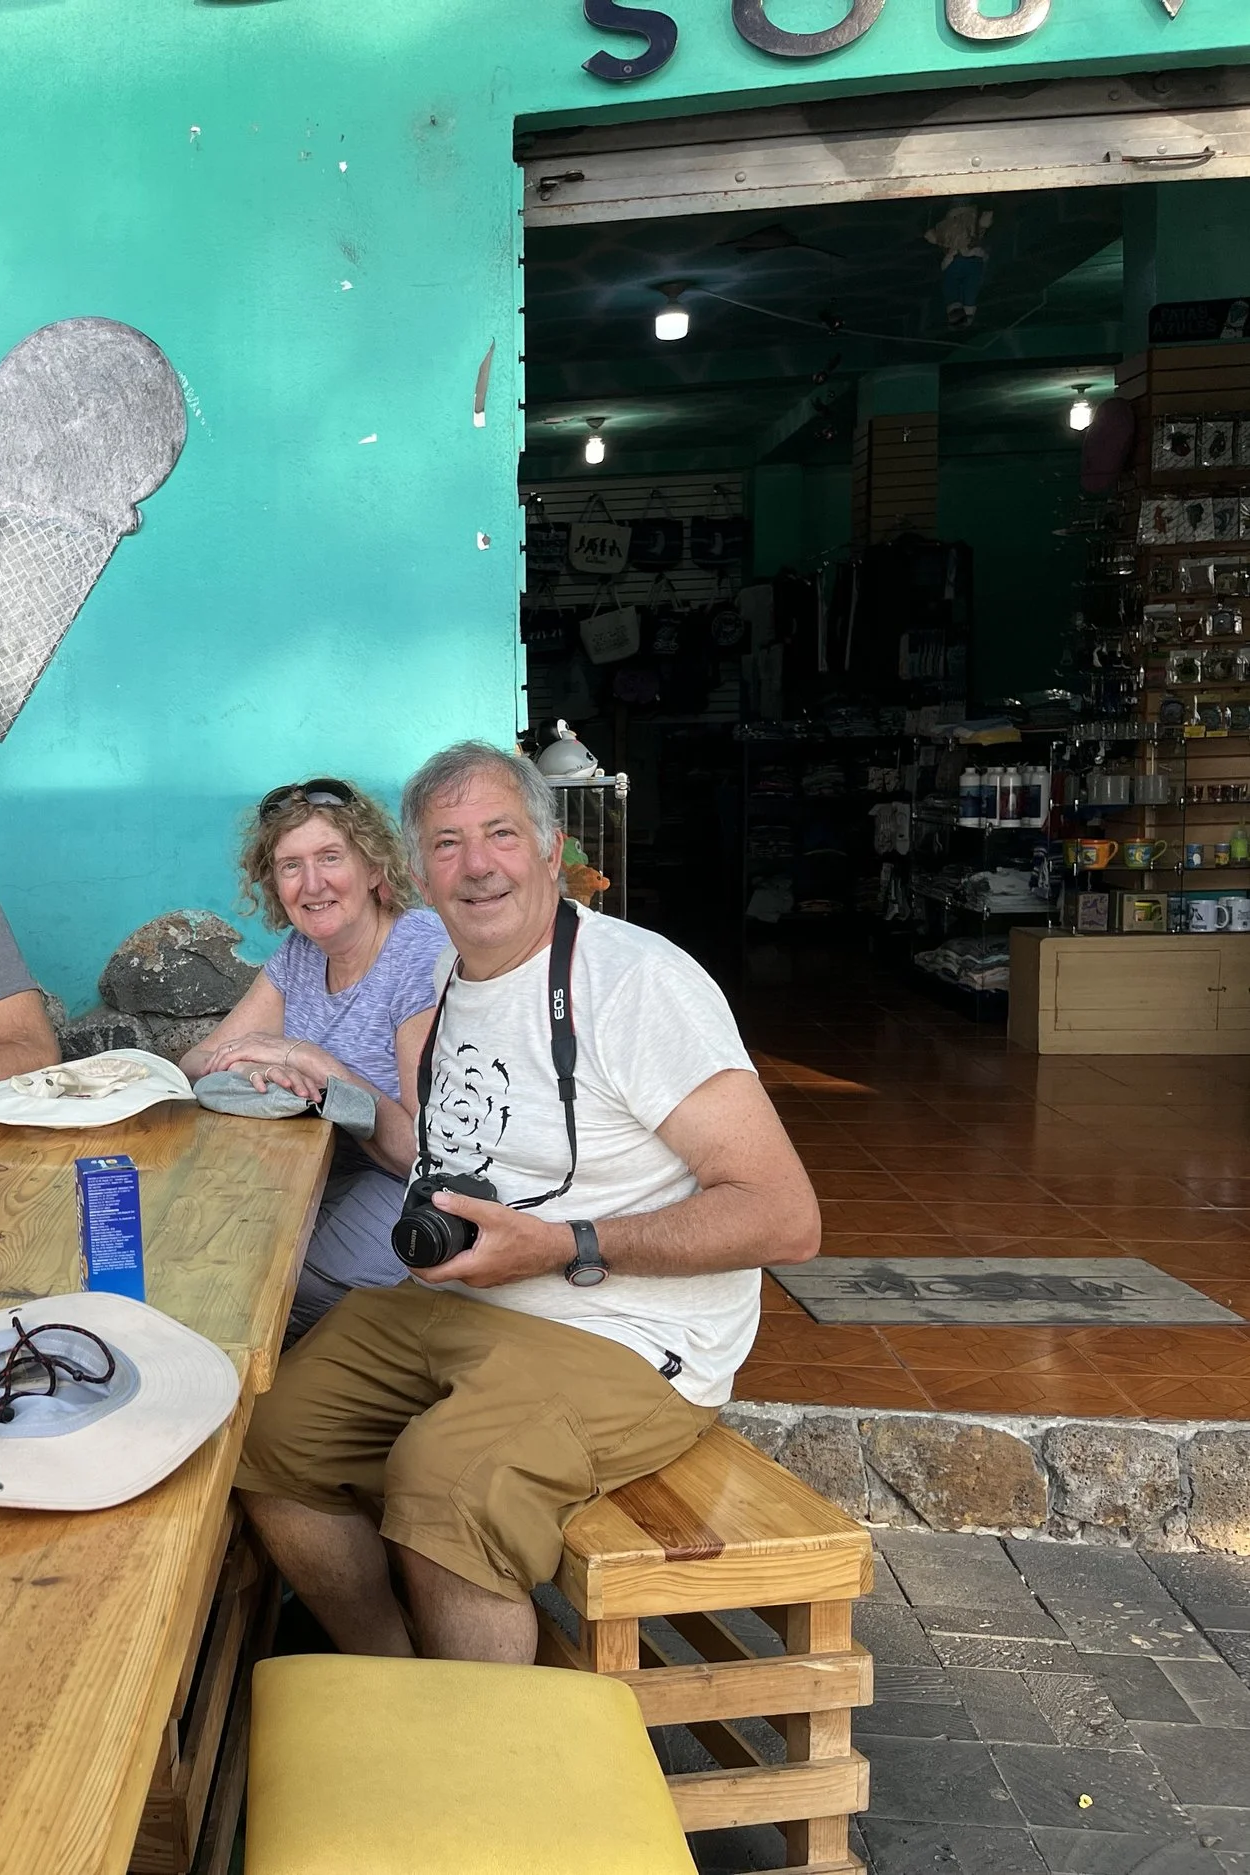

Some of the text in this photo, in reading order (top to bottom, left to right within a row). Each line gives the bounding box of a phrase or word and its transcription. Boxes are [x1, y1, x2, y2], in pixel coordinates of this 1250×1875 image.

[1151, 318, 1219, 337] AZULES
[553, 988, 565, 1020] EOS
[829, 1279, 1146, 1298] WELCOME
